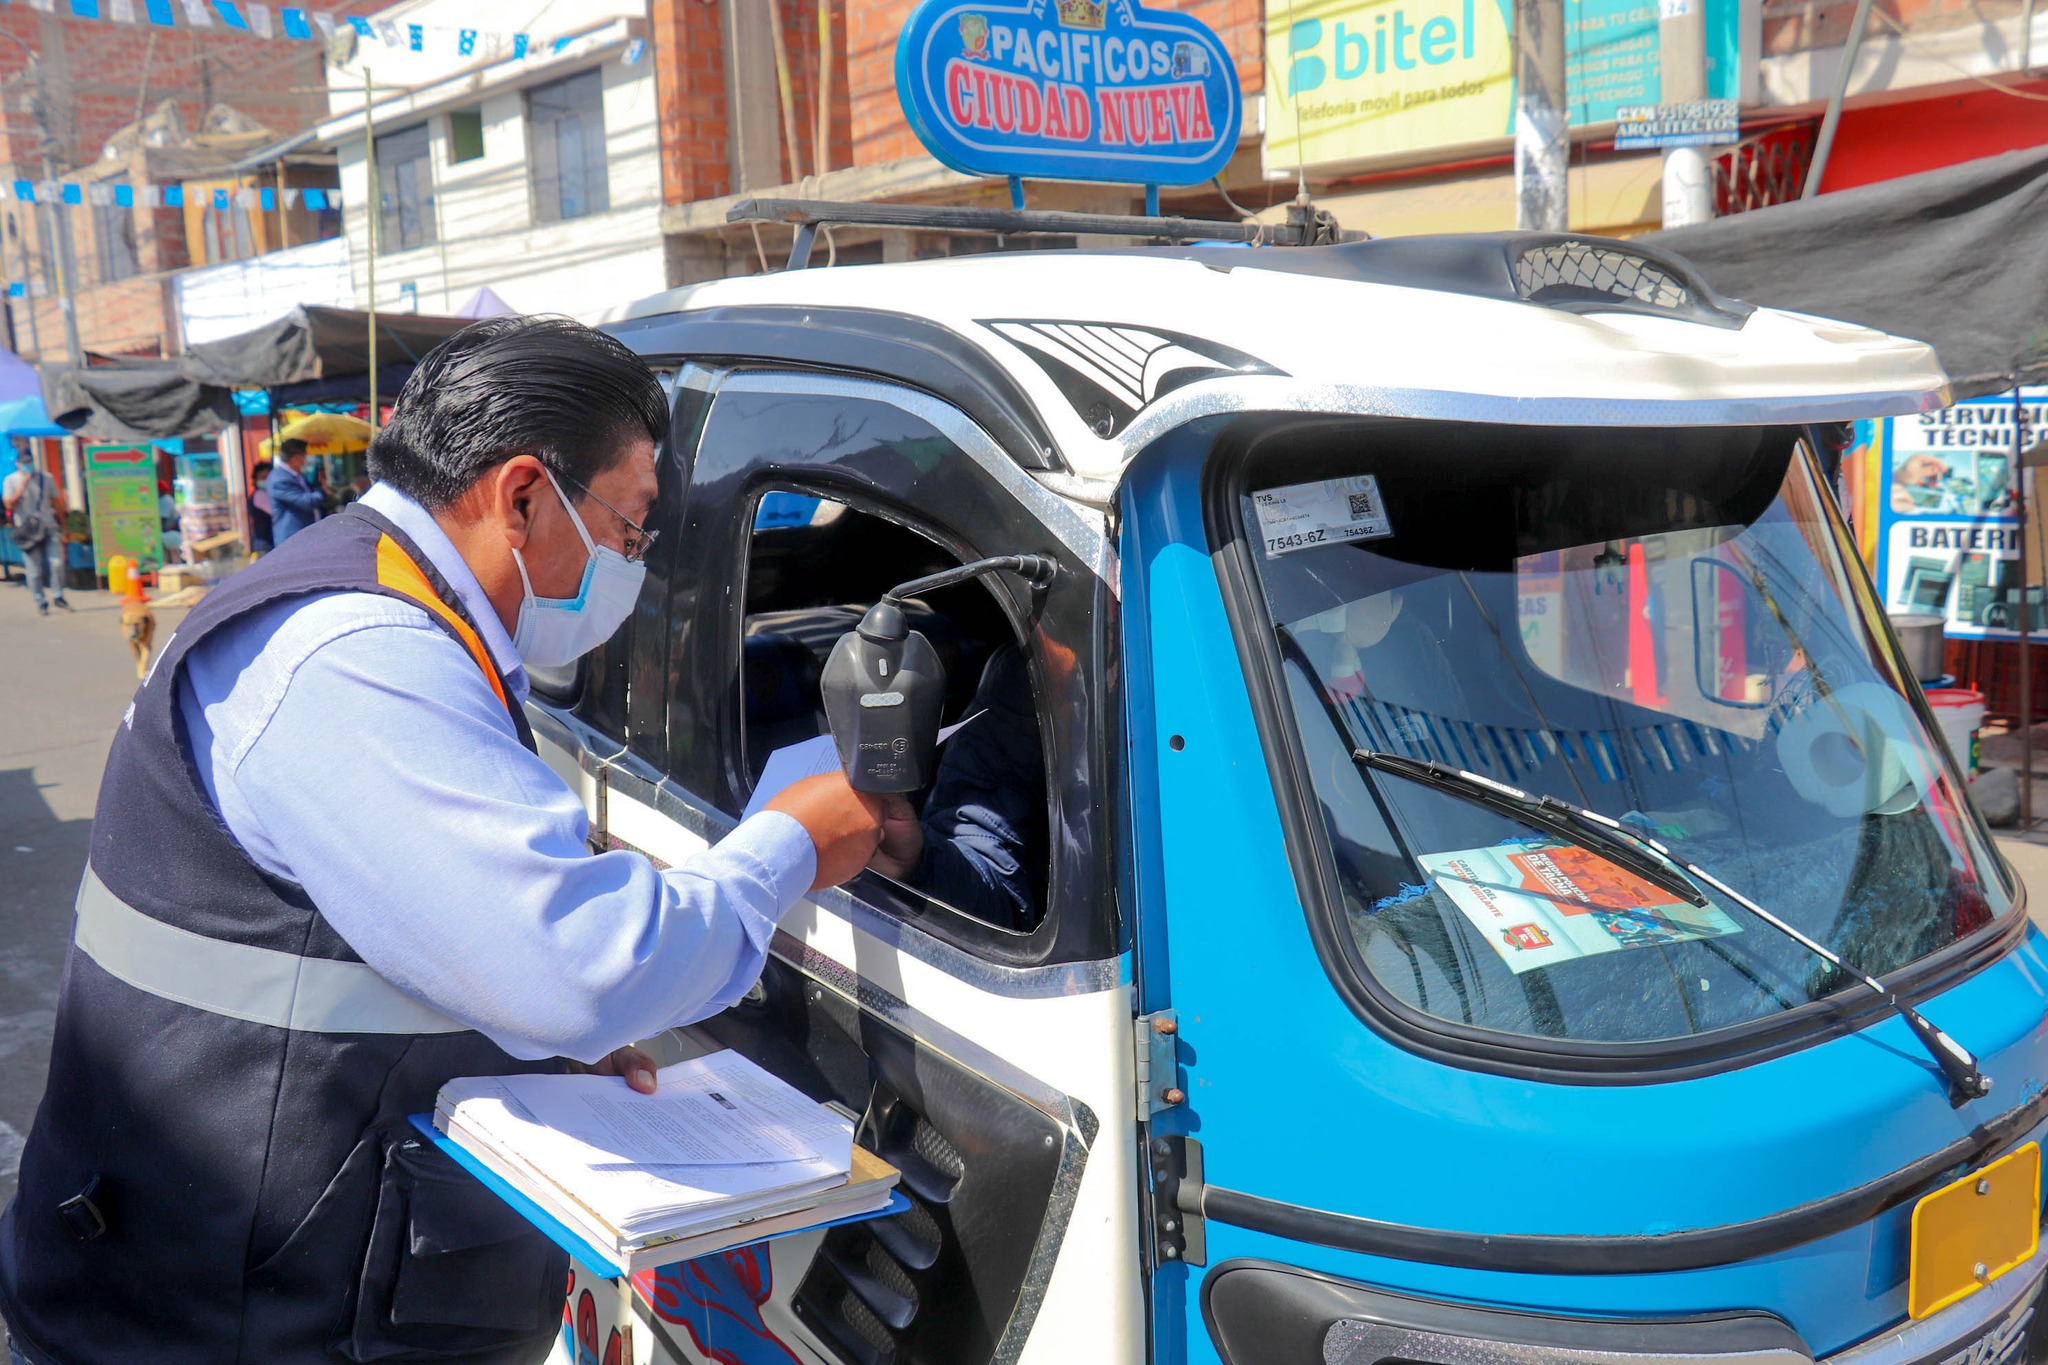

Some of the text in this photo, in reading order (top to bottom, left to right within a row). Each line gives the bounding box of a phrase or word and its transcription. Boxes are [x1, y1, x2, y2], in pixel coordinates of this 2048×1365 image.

[992, 26, 1171, 84] PACIFICOS
[1335, 0, 1474, 81] bitel
[946, 60, 1215, 146] CIUDAD NUEVA
[1404, 89, 1436, 110] para
[1441, 80, 1486, 99] todos
[1617, 118, 1739, 137] ARQUITECTOS
[1918, 407, 2048, 426] SERVICI
[1256, 494, 1273, 502] TVS
[1268, 529, 1326, 551] 7543-6Z
[1525, 853, 1545, 868] DE
[1538, 866, 1573, 896] TACNA
[1467, 884, 1503, 918] VIGILANTE
[1482, 886, 1498, 901] DEL
